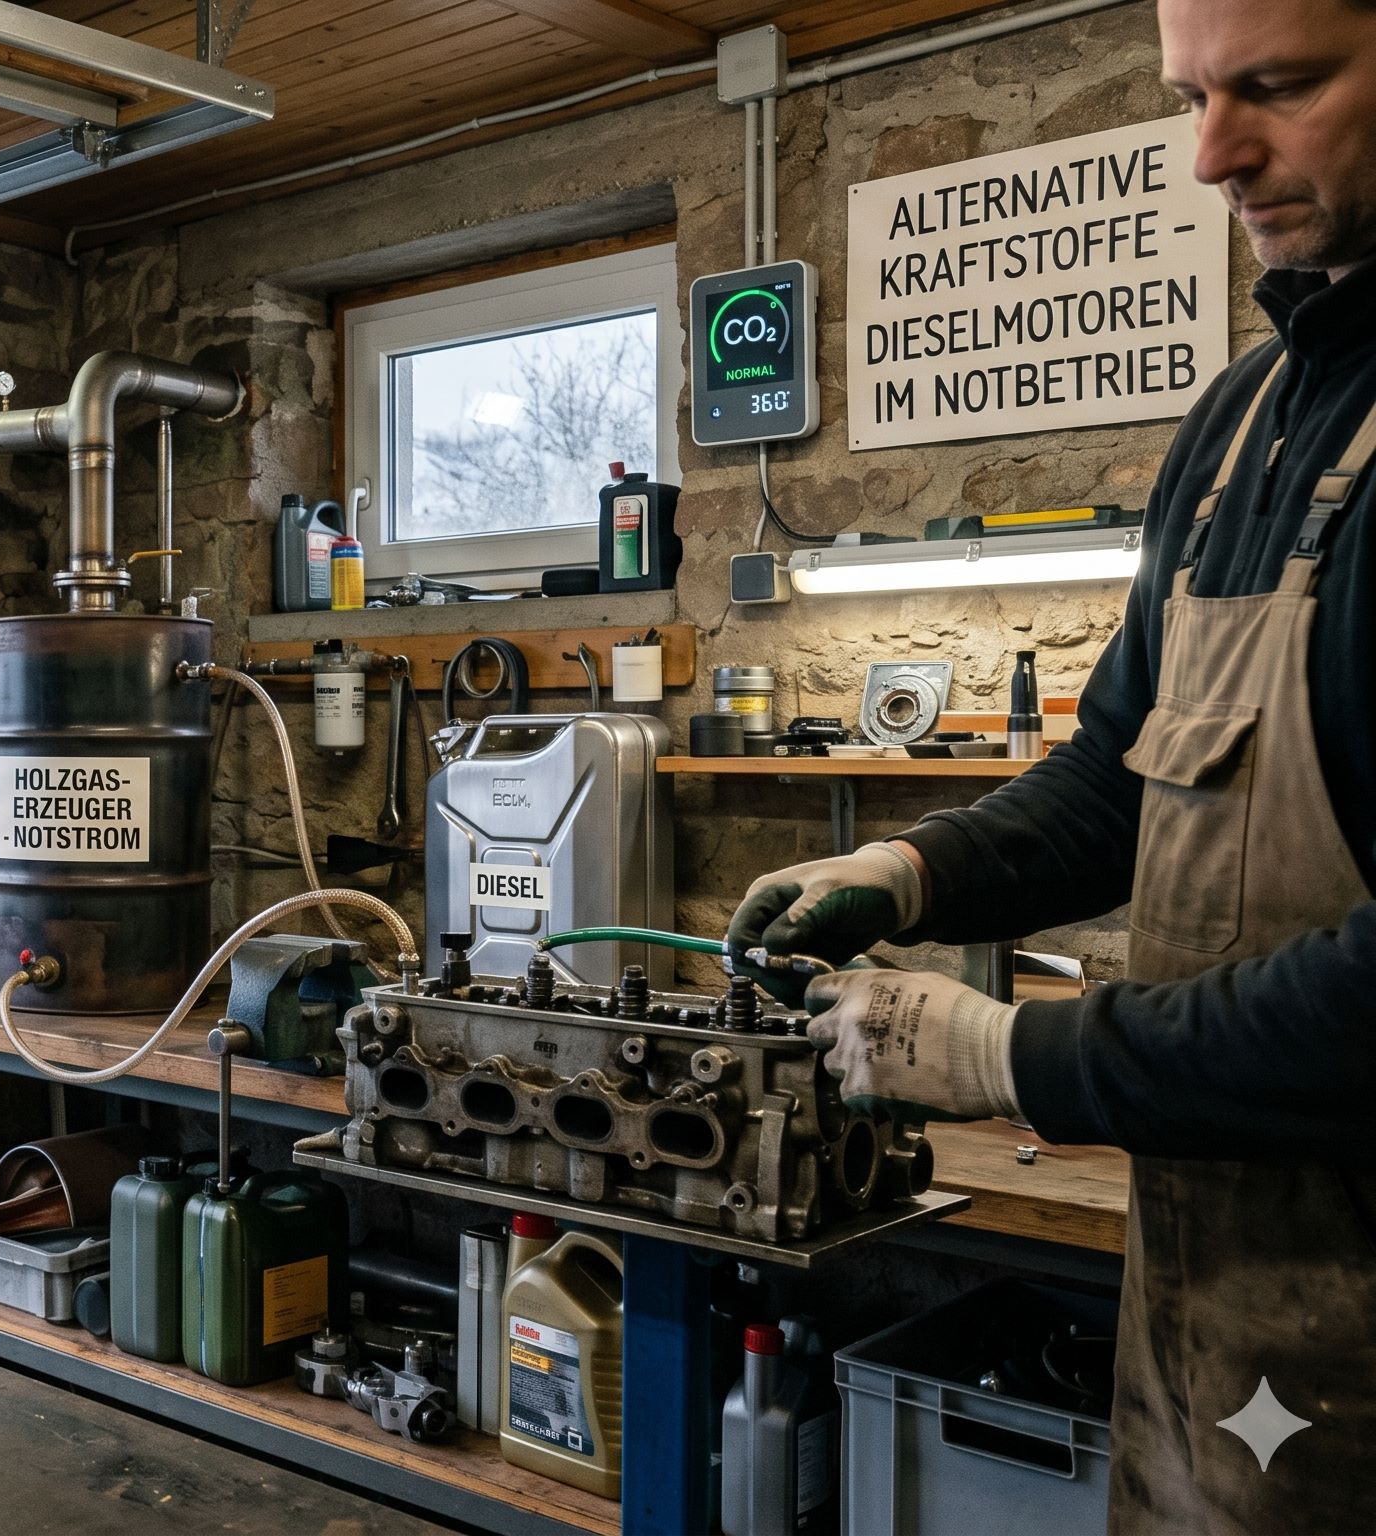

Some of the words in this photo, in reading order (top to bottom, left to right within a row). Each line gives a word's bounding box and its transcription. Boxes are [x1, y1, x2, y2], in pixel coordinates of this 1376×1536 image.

[888, 143, 1167, 241] ALTERNATIVE
[879, 209, 1159, 301] KRAFTSTOFFE
[866, 274, 1198, 366] DIESELMOTOREN
[726, 364, 776, 381] NORMAL
[875, 377, 914, 424] IM
[935, 342, 1197, 417] NOTBETRIEB
[15, 768, 131, 791] HOLZGAS-
[13, 797, 132, 820] ERZEUGER
[477, 873, 544, 900] DIESEL
